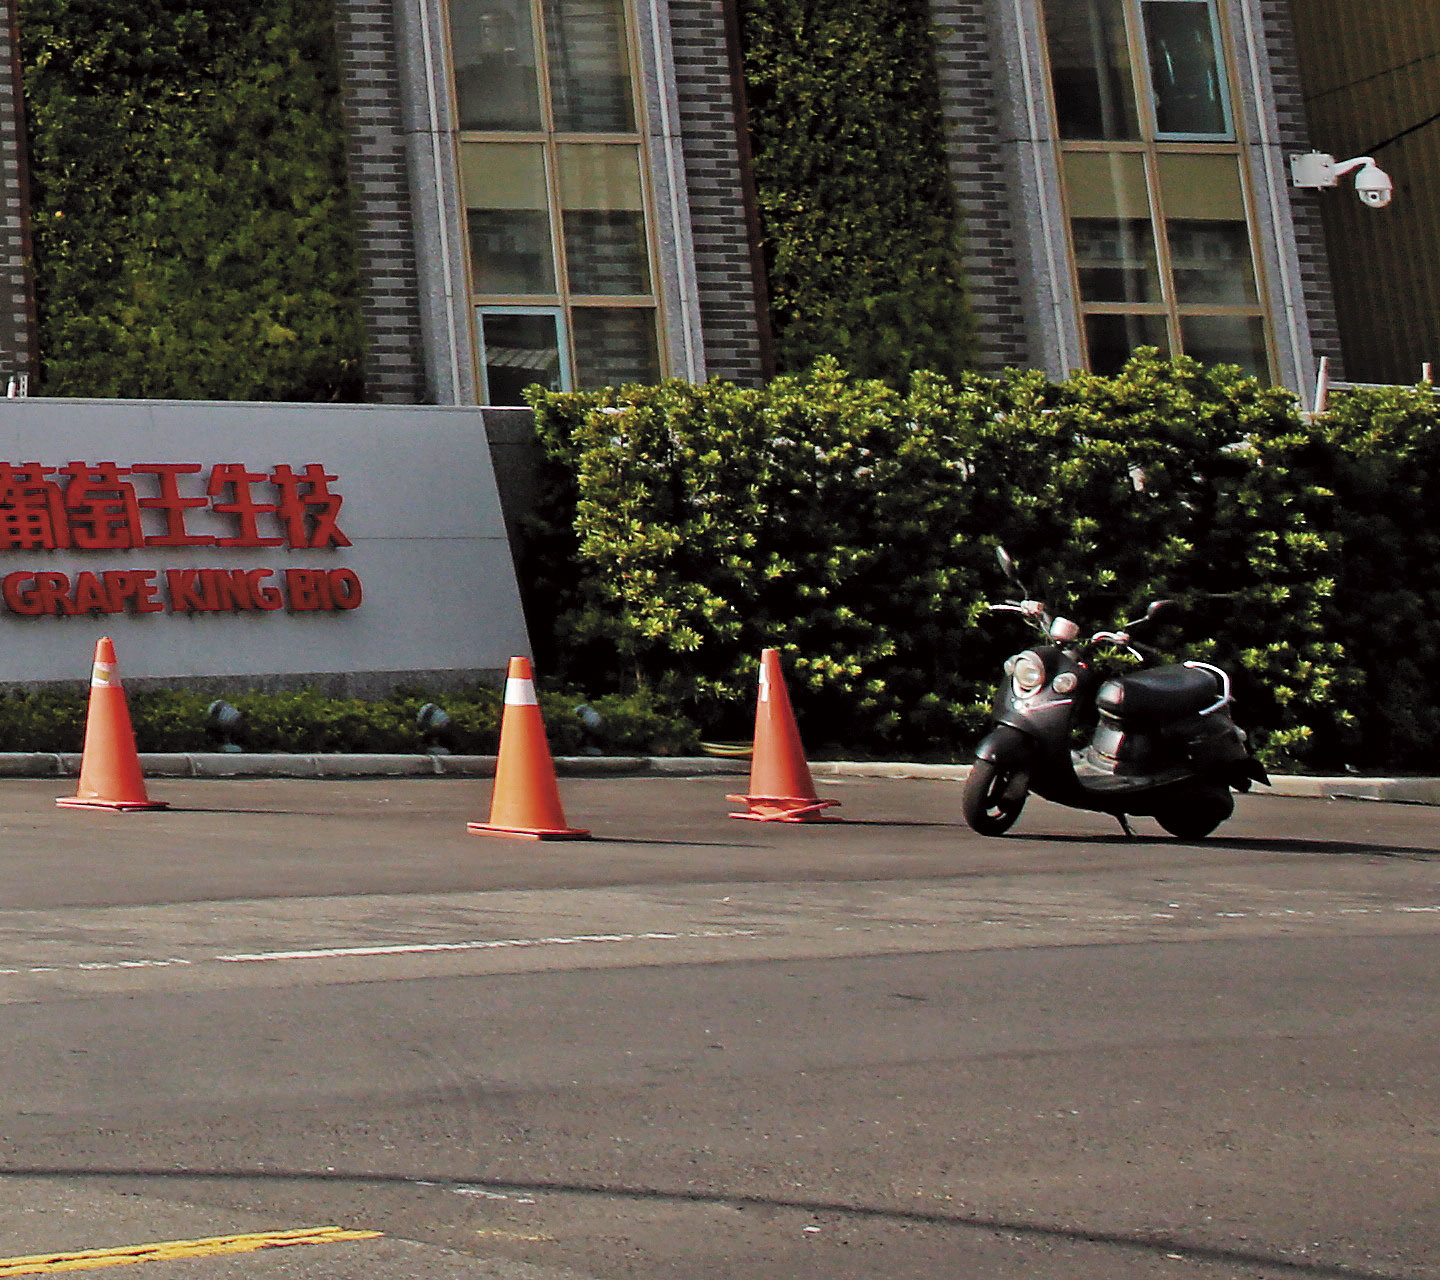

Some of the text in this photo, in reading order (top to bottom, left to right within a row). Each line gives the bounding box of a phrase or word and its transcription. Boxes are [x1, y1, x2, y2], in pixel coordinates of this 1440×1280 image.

[1, 568, 363, 615] GRAPE KING BIO
